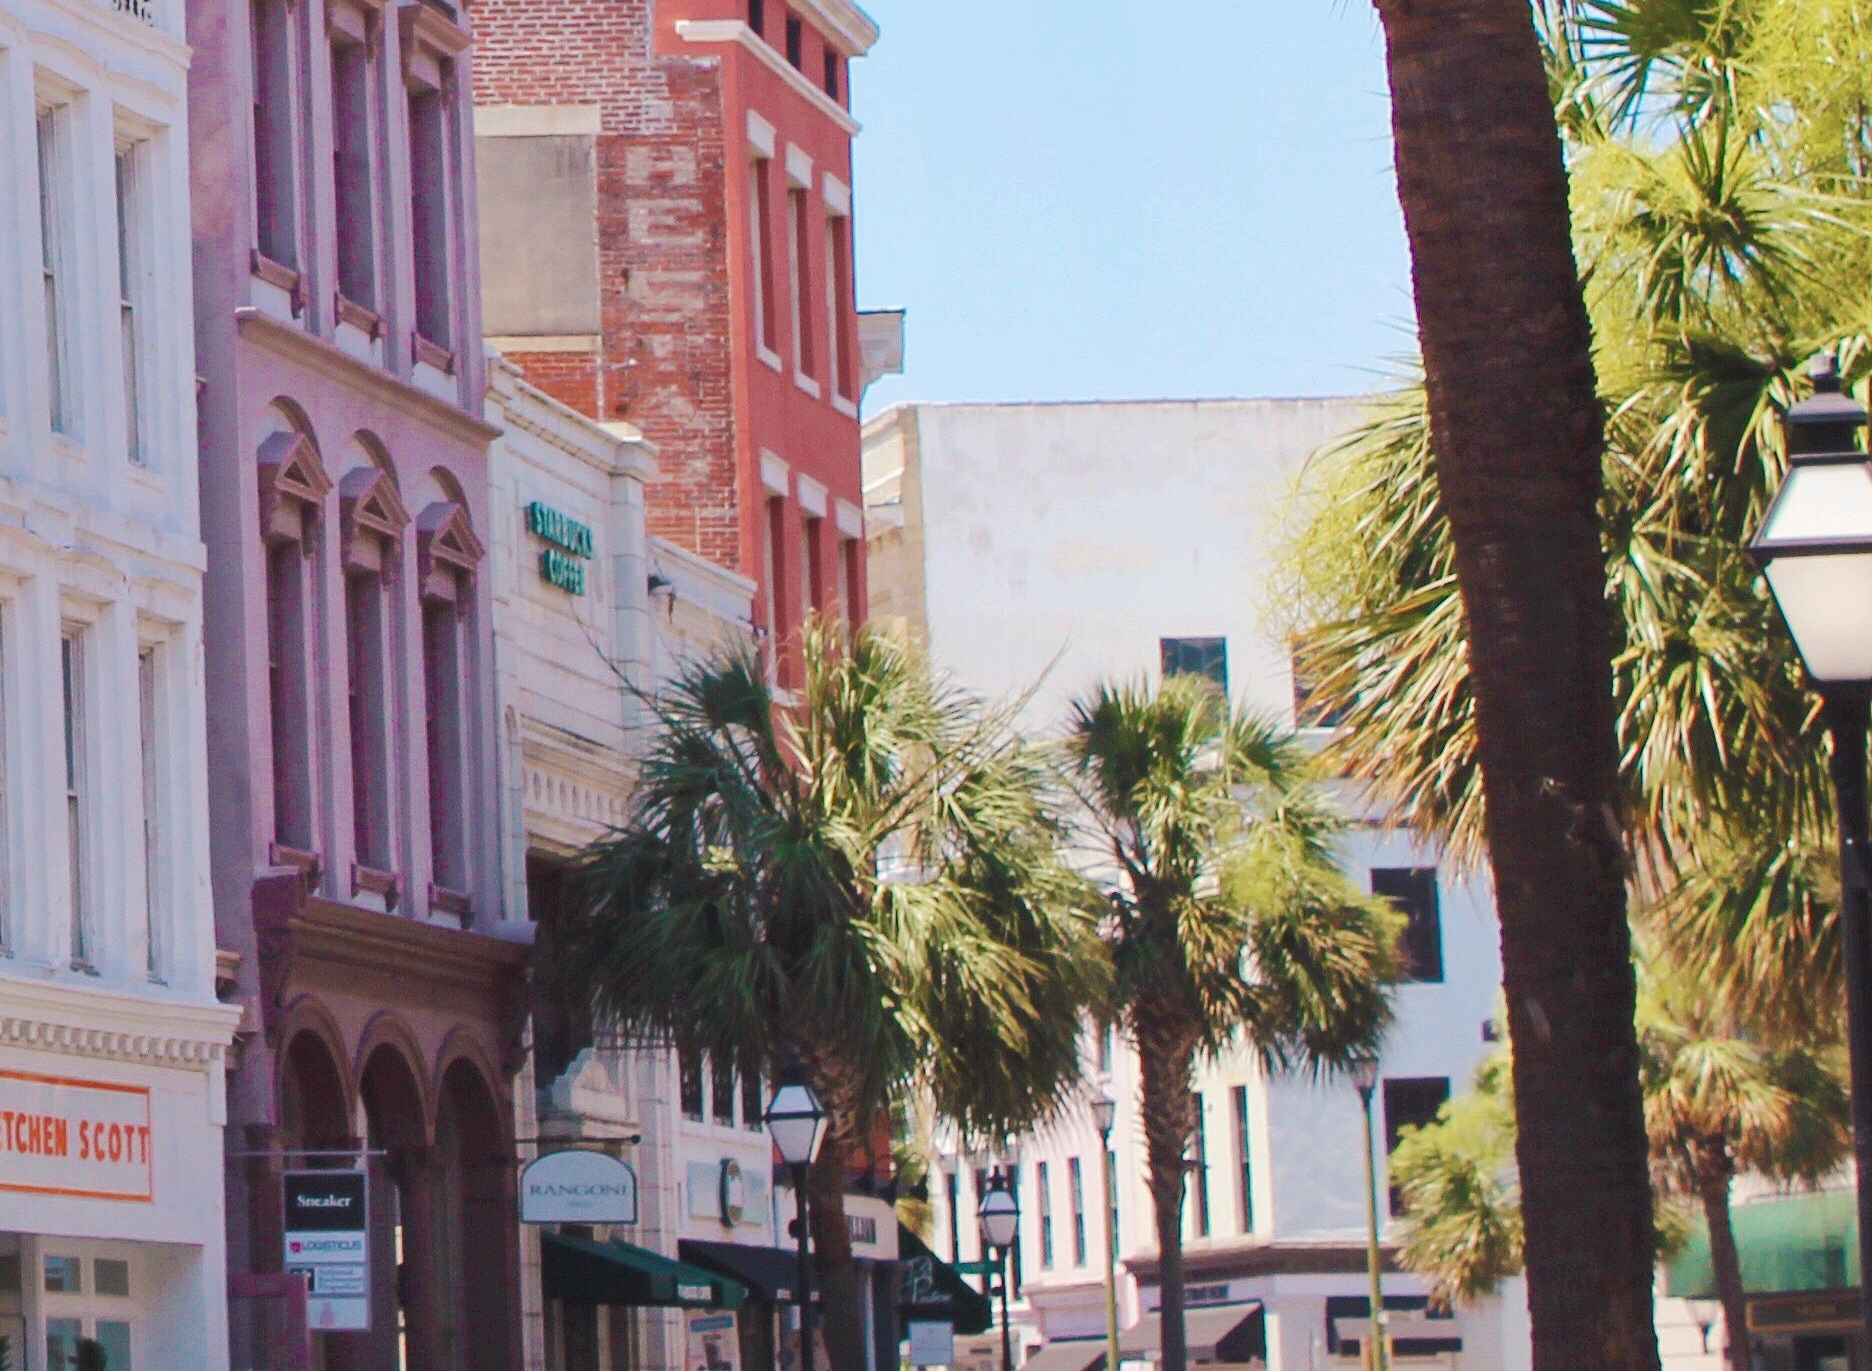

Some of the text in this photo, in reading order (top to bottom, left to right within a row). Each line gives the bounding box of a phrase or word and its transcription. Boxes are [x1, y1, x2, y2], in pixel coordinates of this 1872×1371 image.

[79, 1119, 150, 1164] SCOTT
[530, 1184, 628, 1196] RANGONI
[297, 1193, 352, 1208] Sneaker
